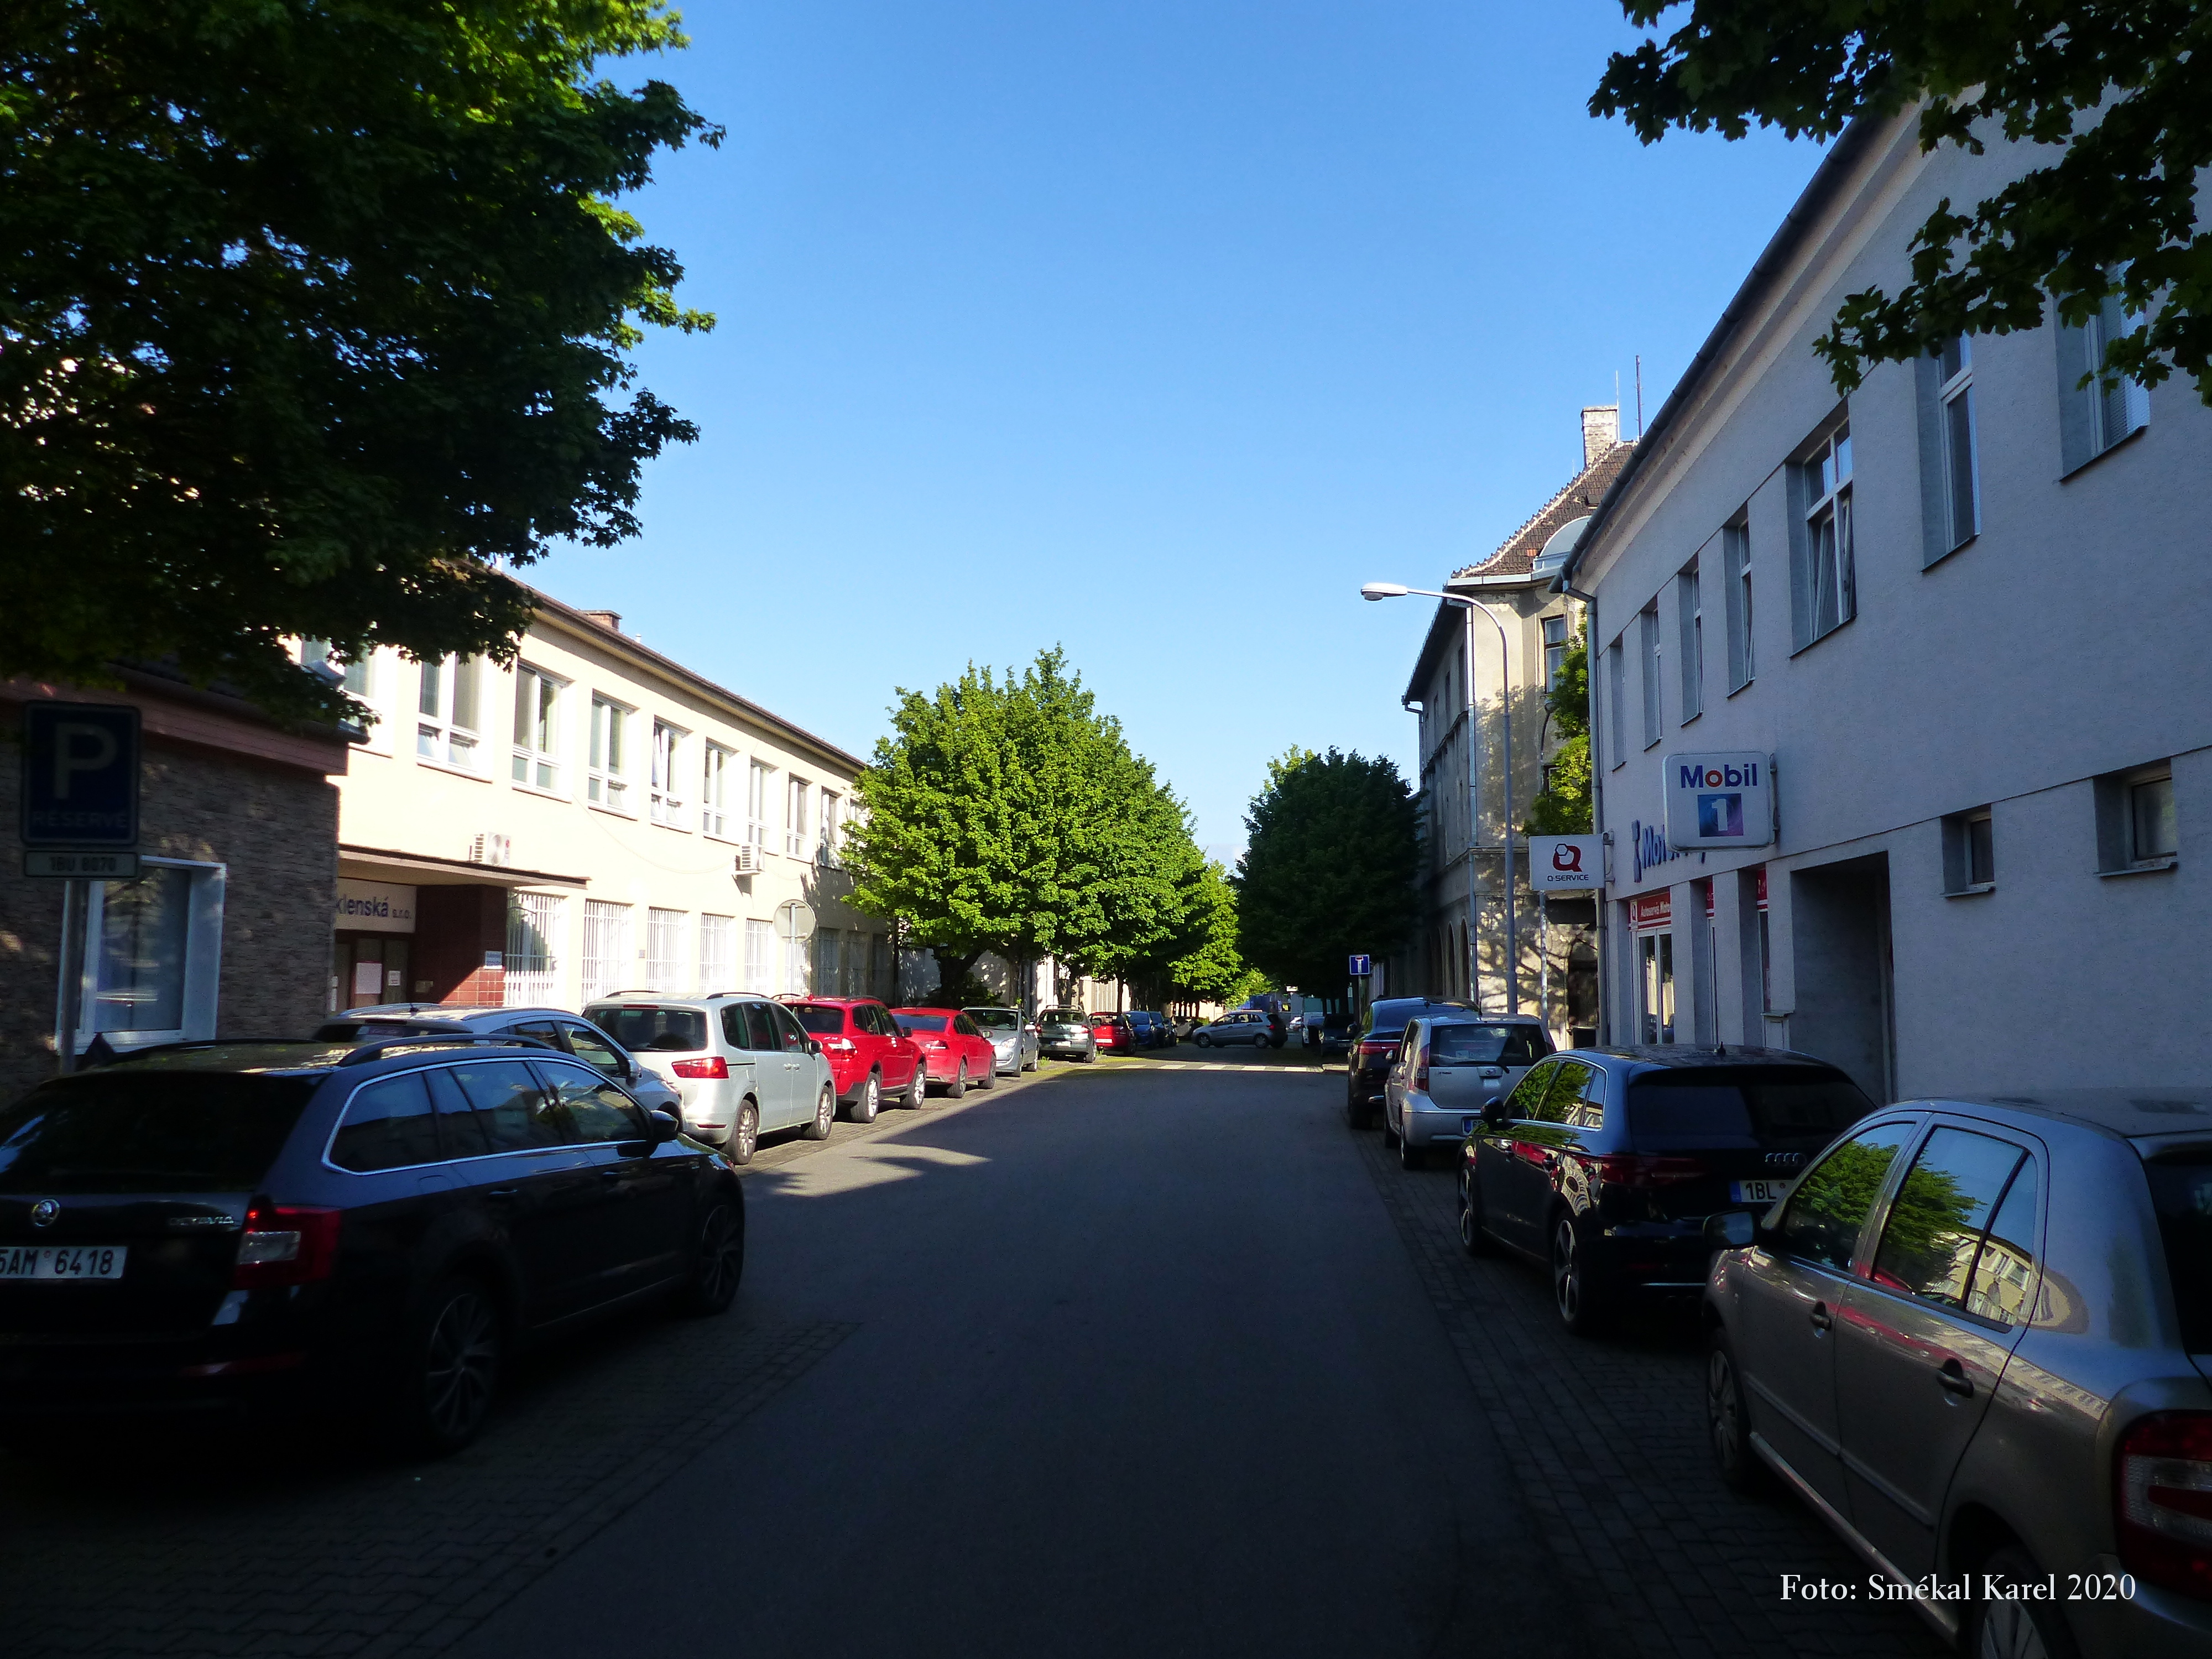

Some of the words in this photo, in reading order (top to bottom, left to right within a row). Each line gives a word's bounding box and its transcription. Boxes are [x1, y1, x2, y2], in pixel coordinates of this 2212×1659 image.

[54, 722, 118, 800] P
[1681, 764, 1757, 788] Mobil
[1712, 799, 1728, 831] 1
[1745, 1182, 1777, 1199] 1BL
[0, 1249, 39, 1275] 5AM
[55, 1249, 113, 1275] 6418
